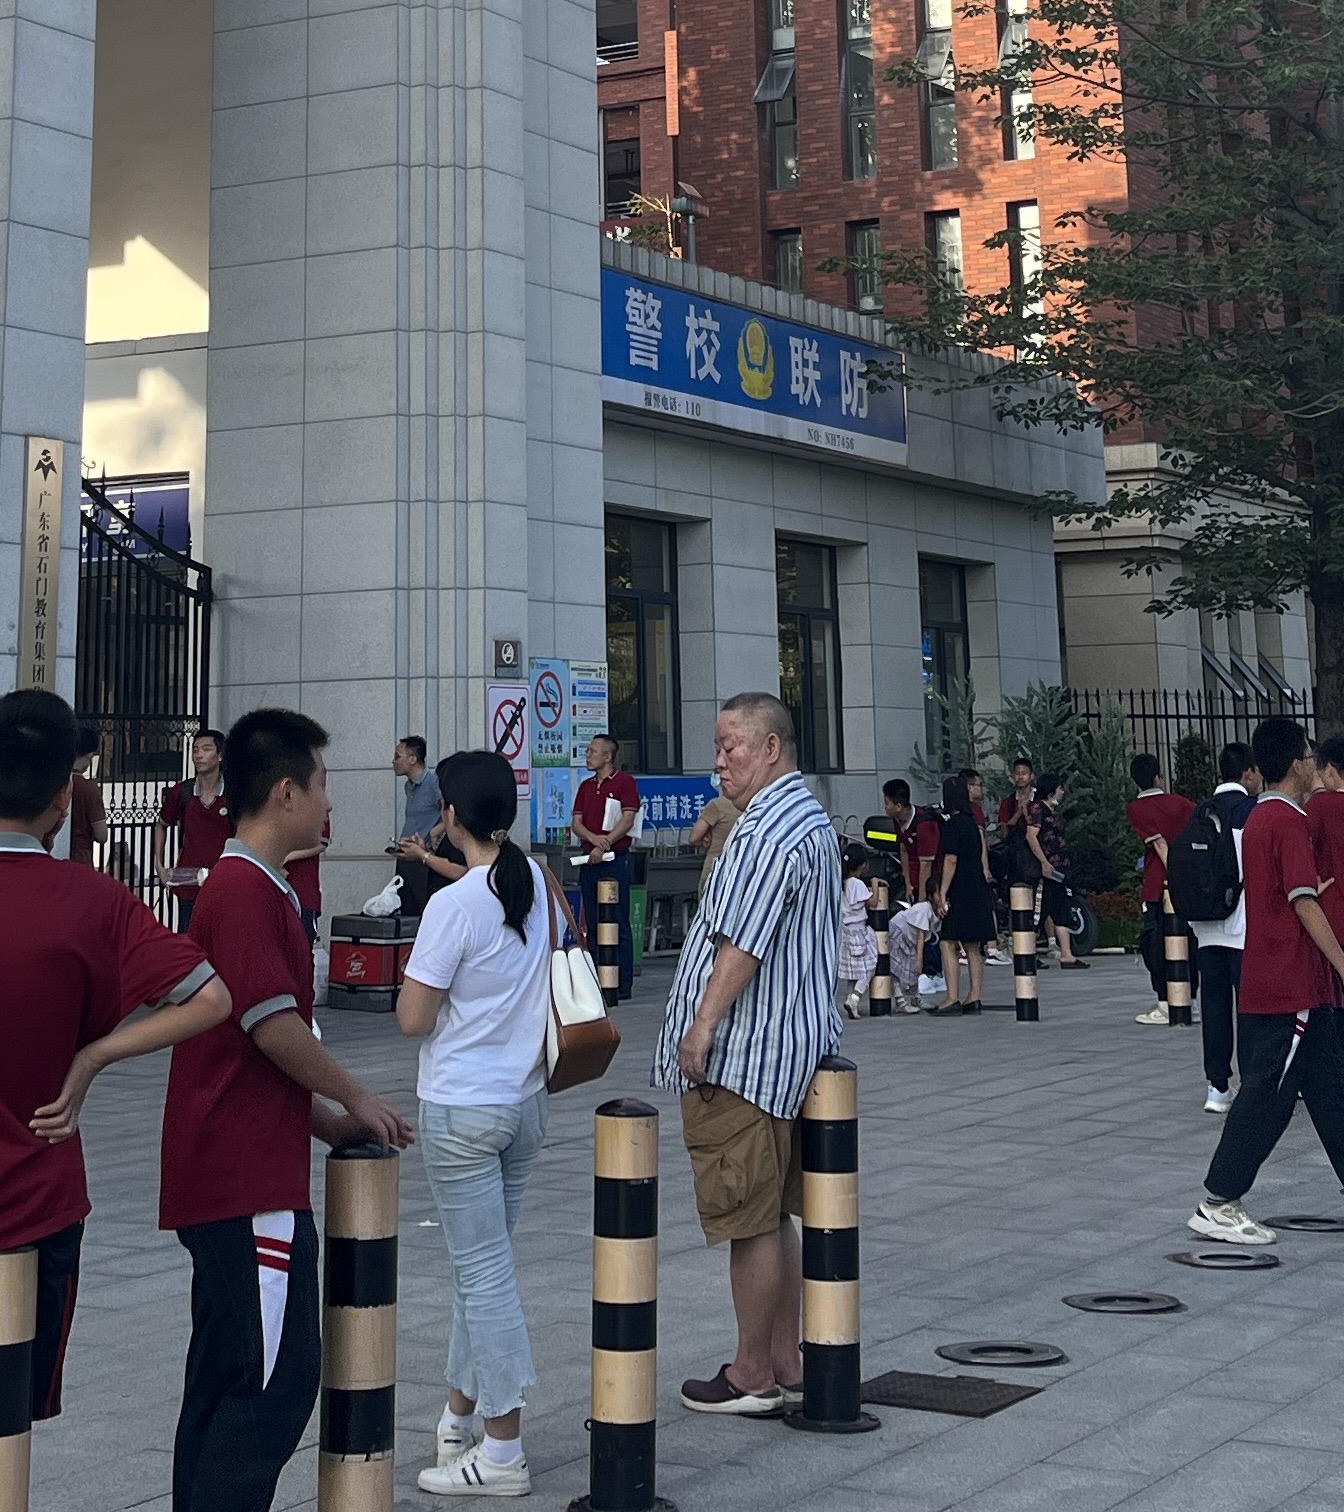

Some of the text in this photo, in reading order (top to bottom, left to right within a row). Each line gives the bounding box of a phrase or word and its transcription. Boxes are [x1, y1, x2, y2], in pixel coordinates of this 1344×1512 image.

[624, 286, 869, 419] 警校联防
[31, 490, 53, 692] 广东省石门教育集团
